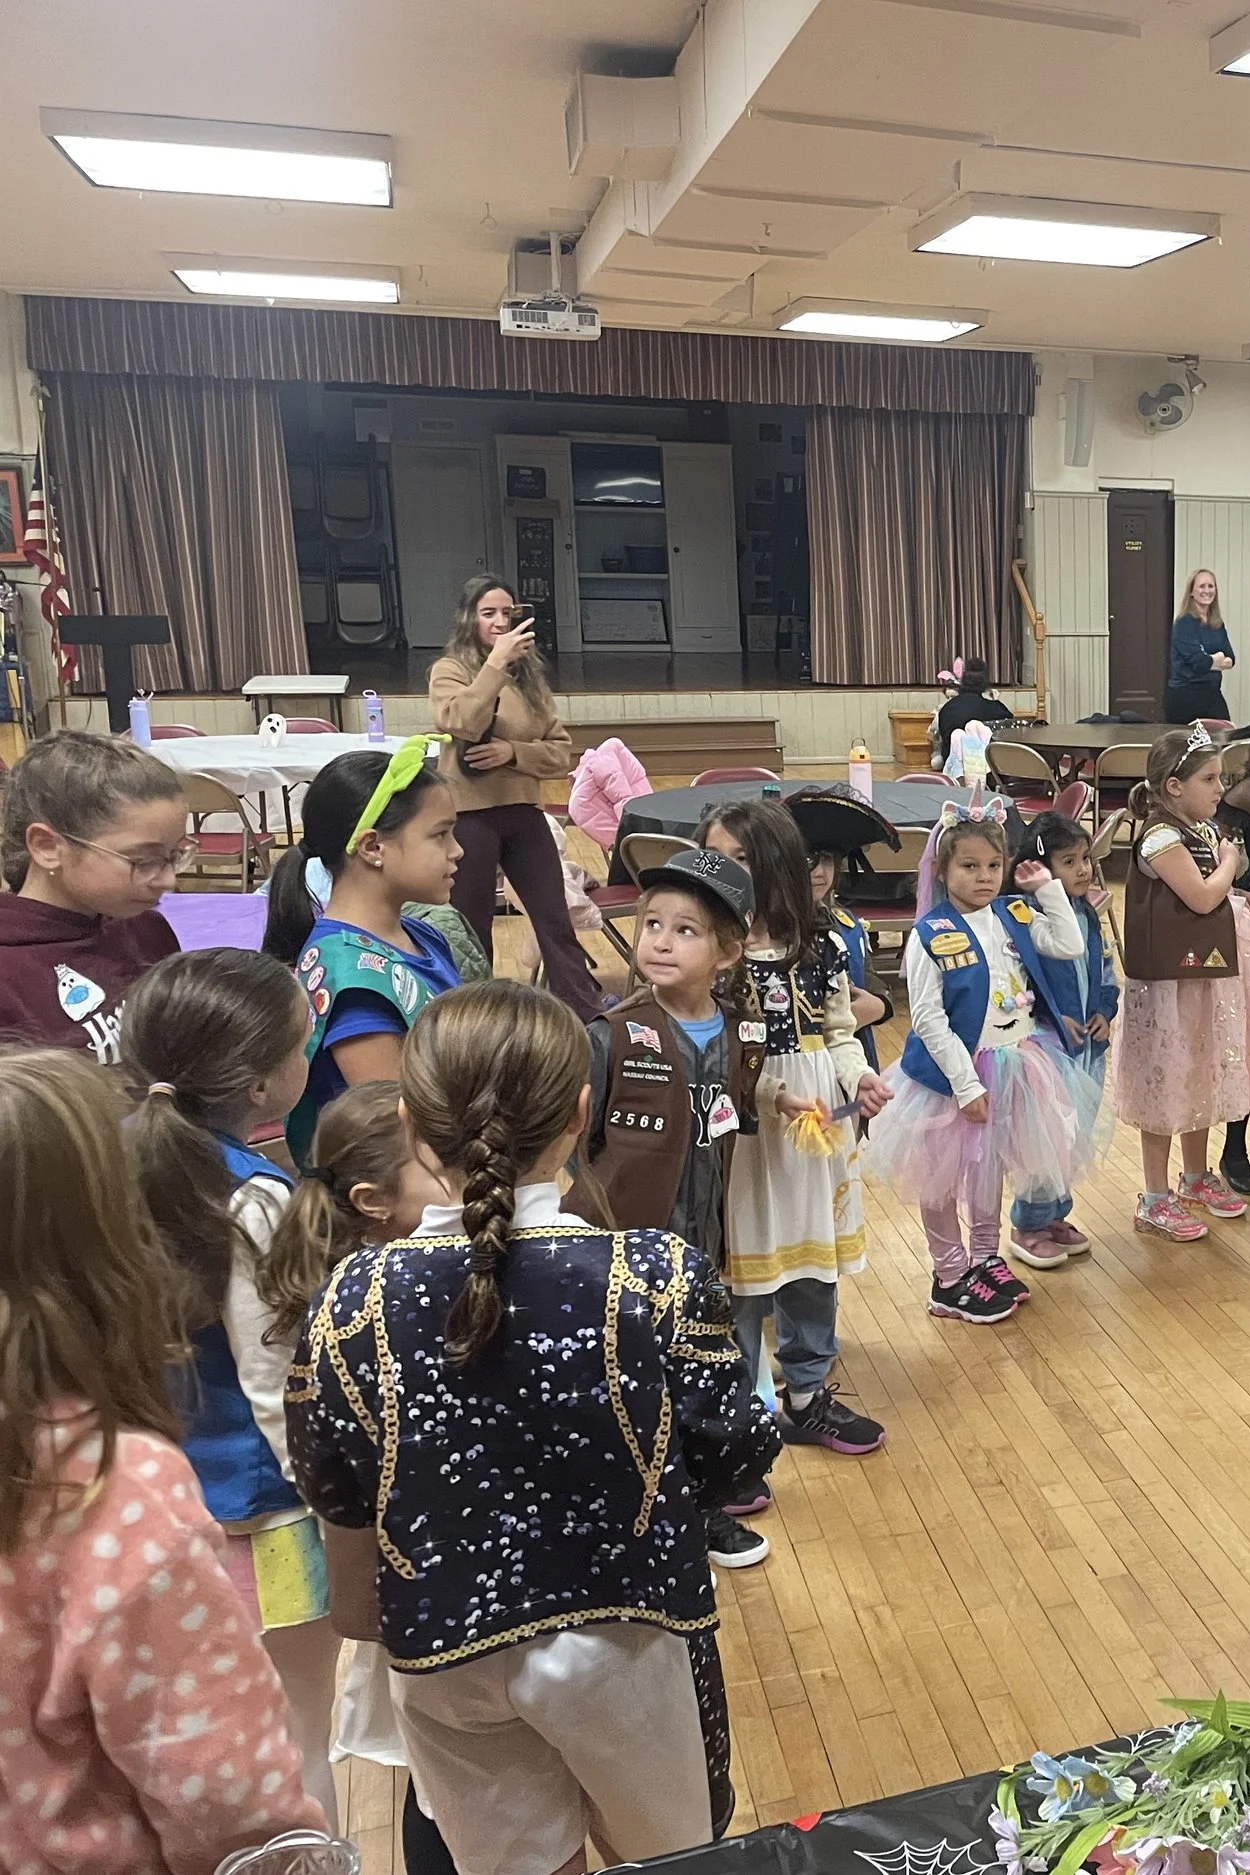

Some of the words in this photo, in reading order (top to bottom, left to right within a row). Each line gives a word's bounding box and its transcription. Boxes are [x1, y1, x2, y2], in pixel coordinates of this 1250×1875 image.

[740, 1023, 765, 1041] Molly
[623, 1059, 637, 1068] GIRL
[637, 1061, 660, 1070] SCOUTS
[660, 1063, 673, 1072] USA
[645, 1073, 670, 1083] COUNCIL
[610, 1110, 665, 1132] 2568
